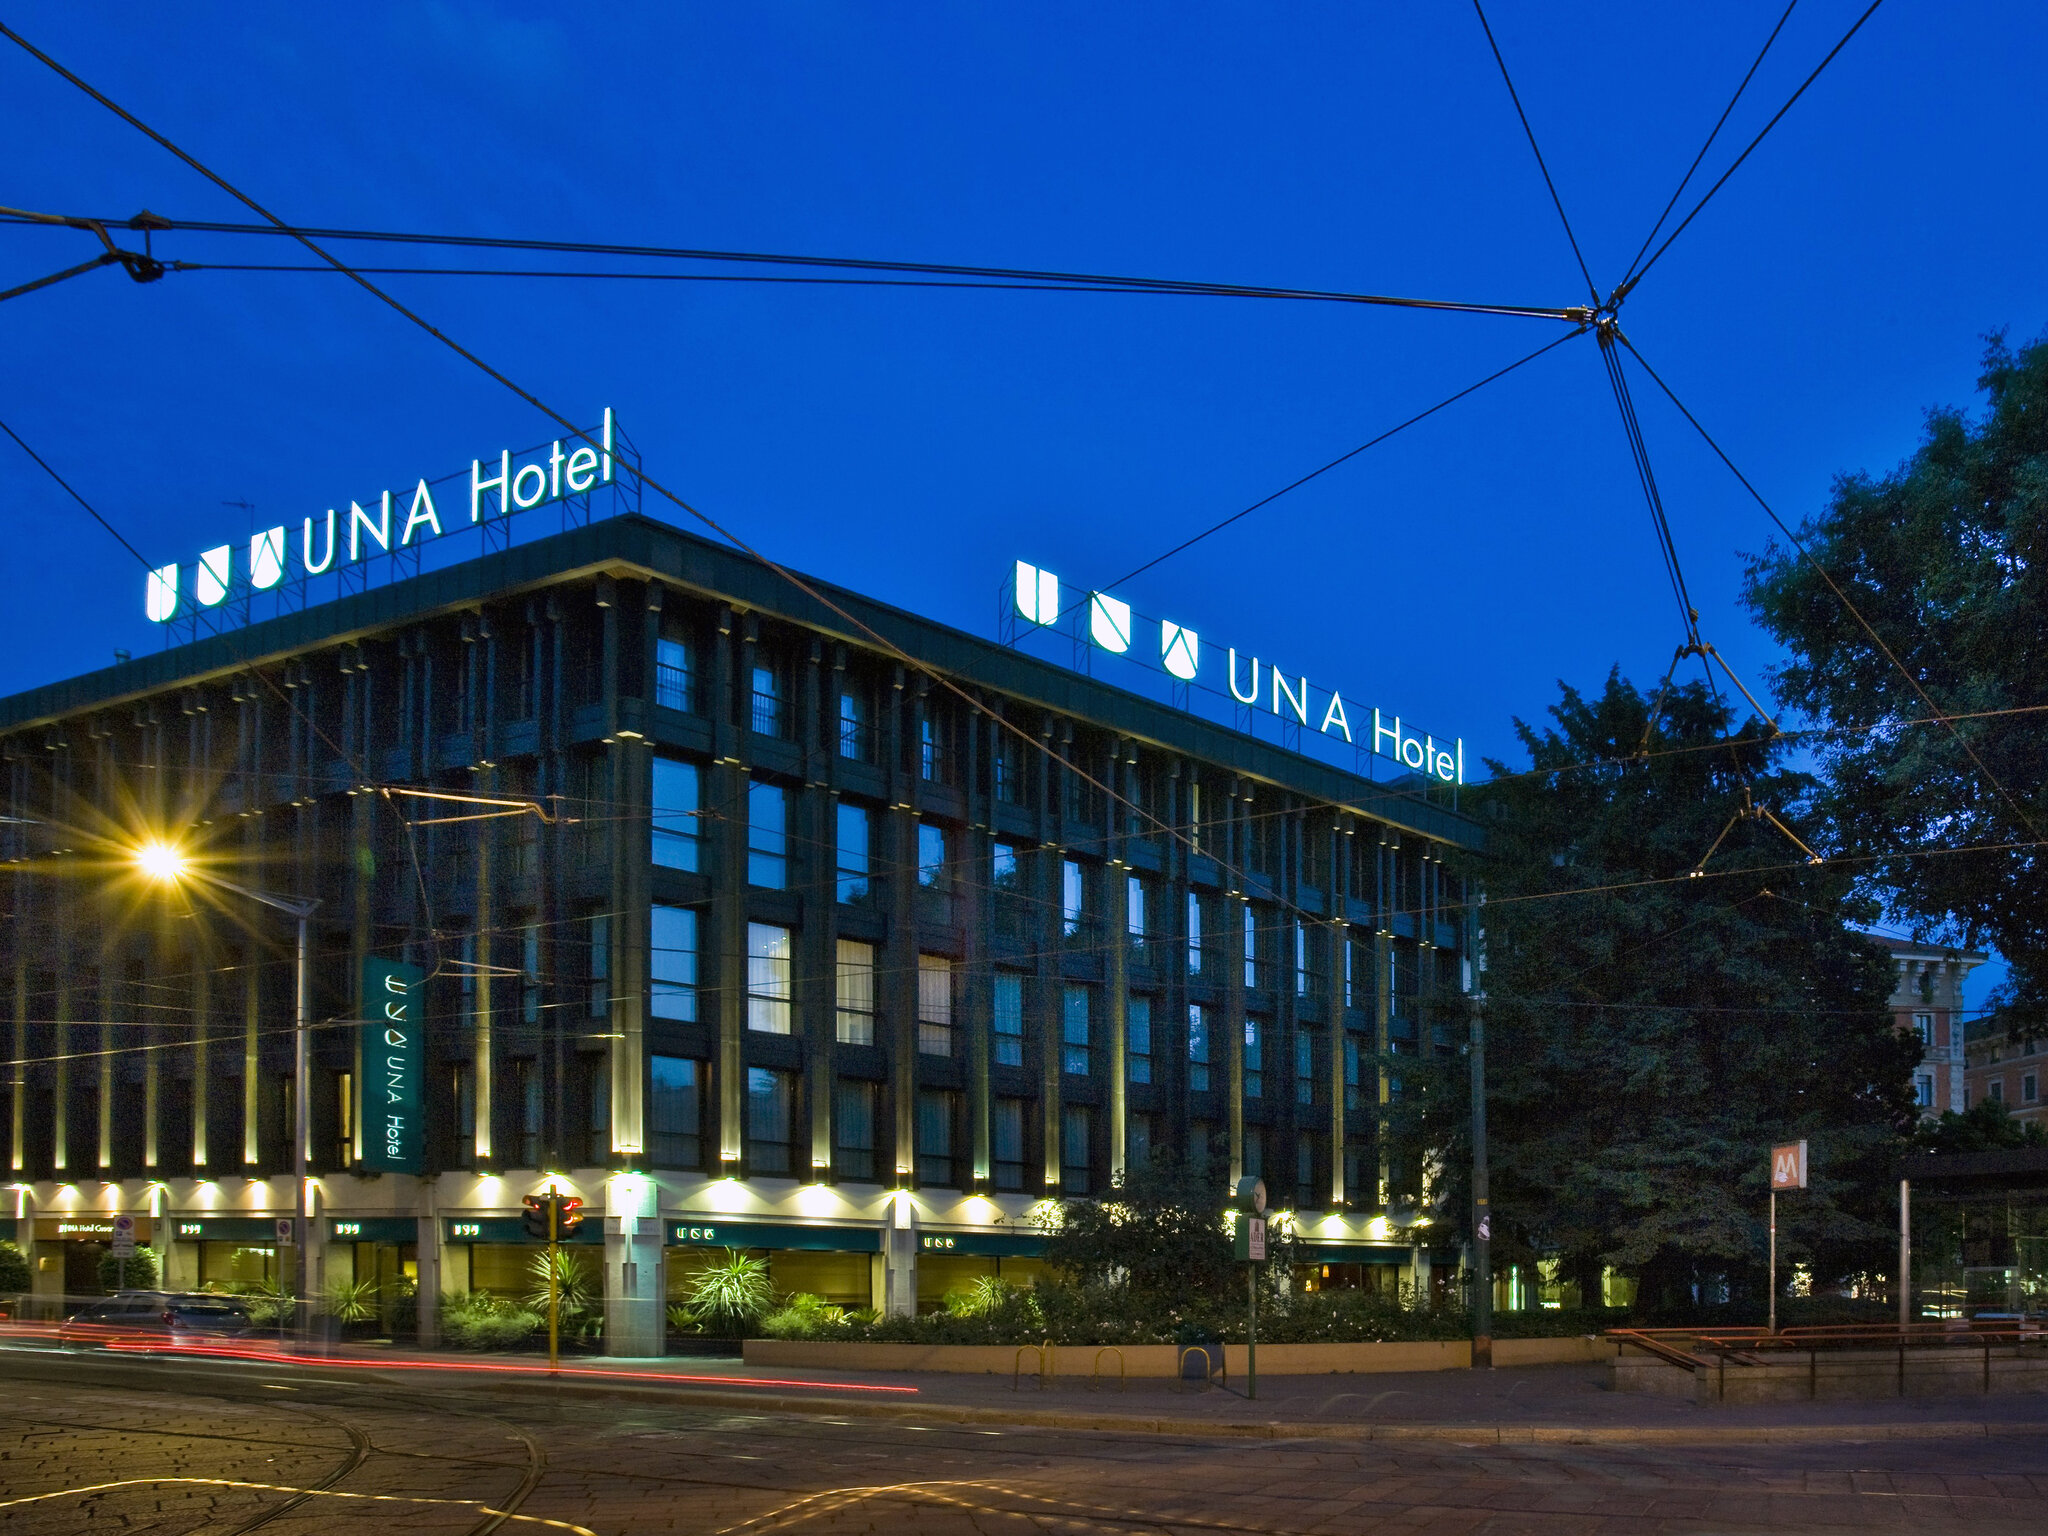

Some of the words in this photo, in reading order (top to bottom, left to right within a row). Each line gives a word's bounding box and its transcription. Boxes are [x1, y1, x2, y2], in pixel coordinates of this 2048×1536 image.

[302, 477, 442, 575] UNA
[470, 405, 614, 523] Hotel
[1228, 646, 1353, 744] UNA
[1373, 706, 1464, 787] Hotel
[386, 1056, 406, 1104] UNA
[386, 1114, 407, 1160] Hotel
[1774, 1153, 1798, 1181] M
